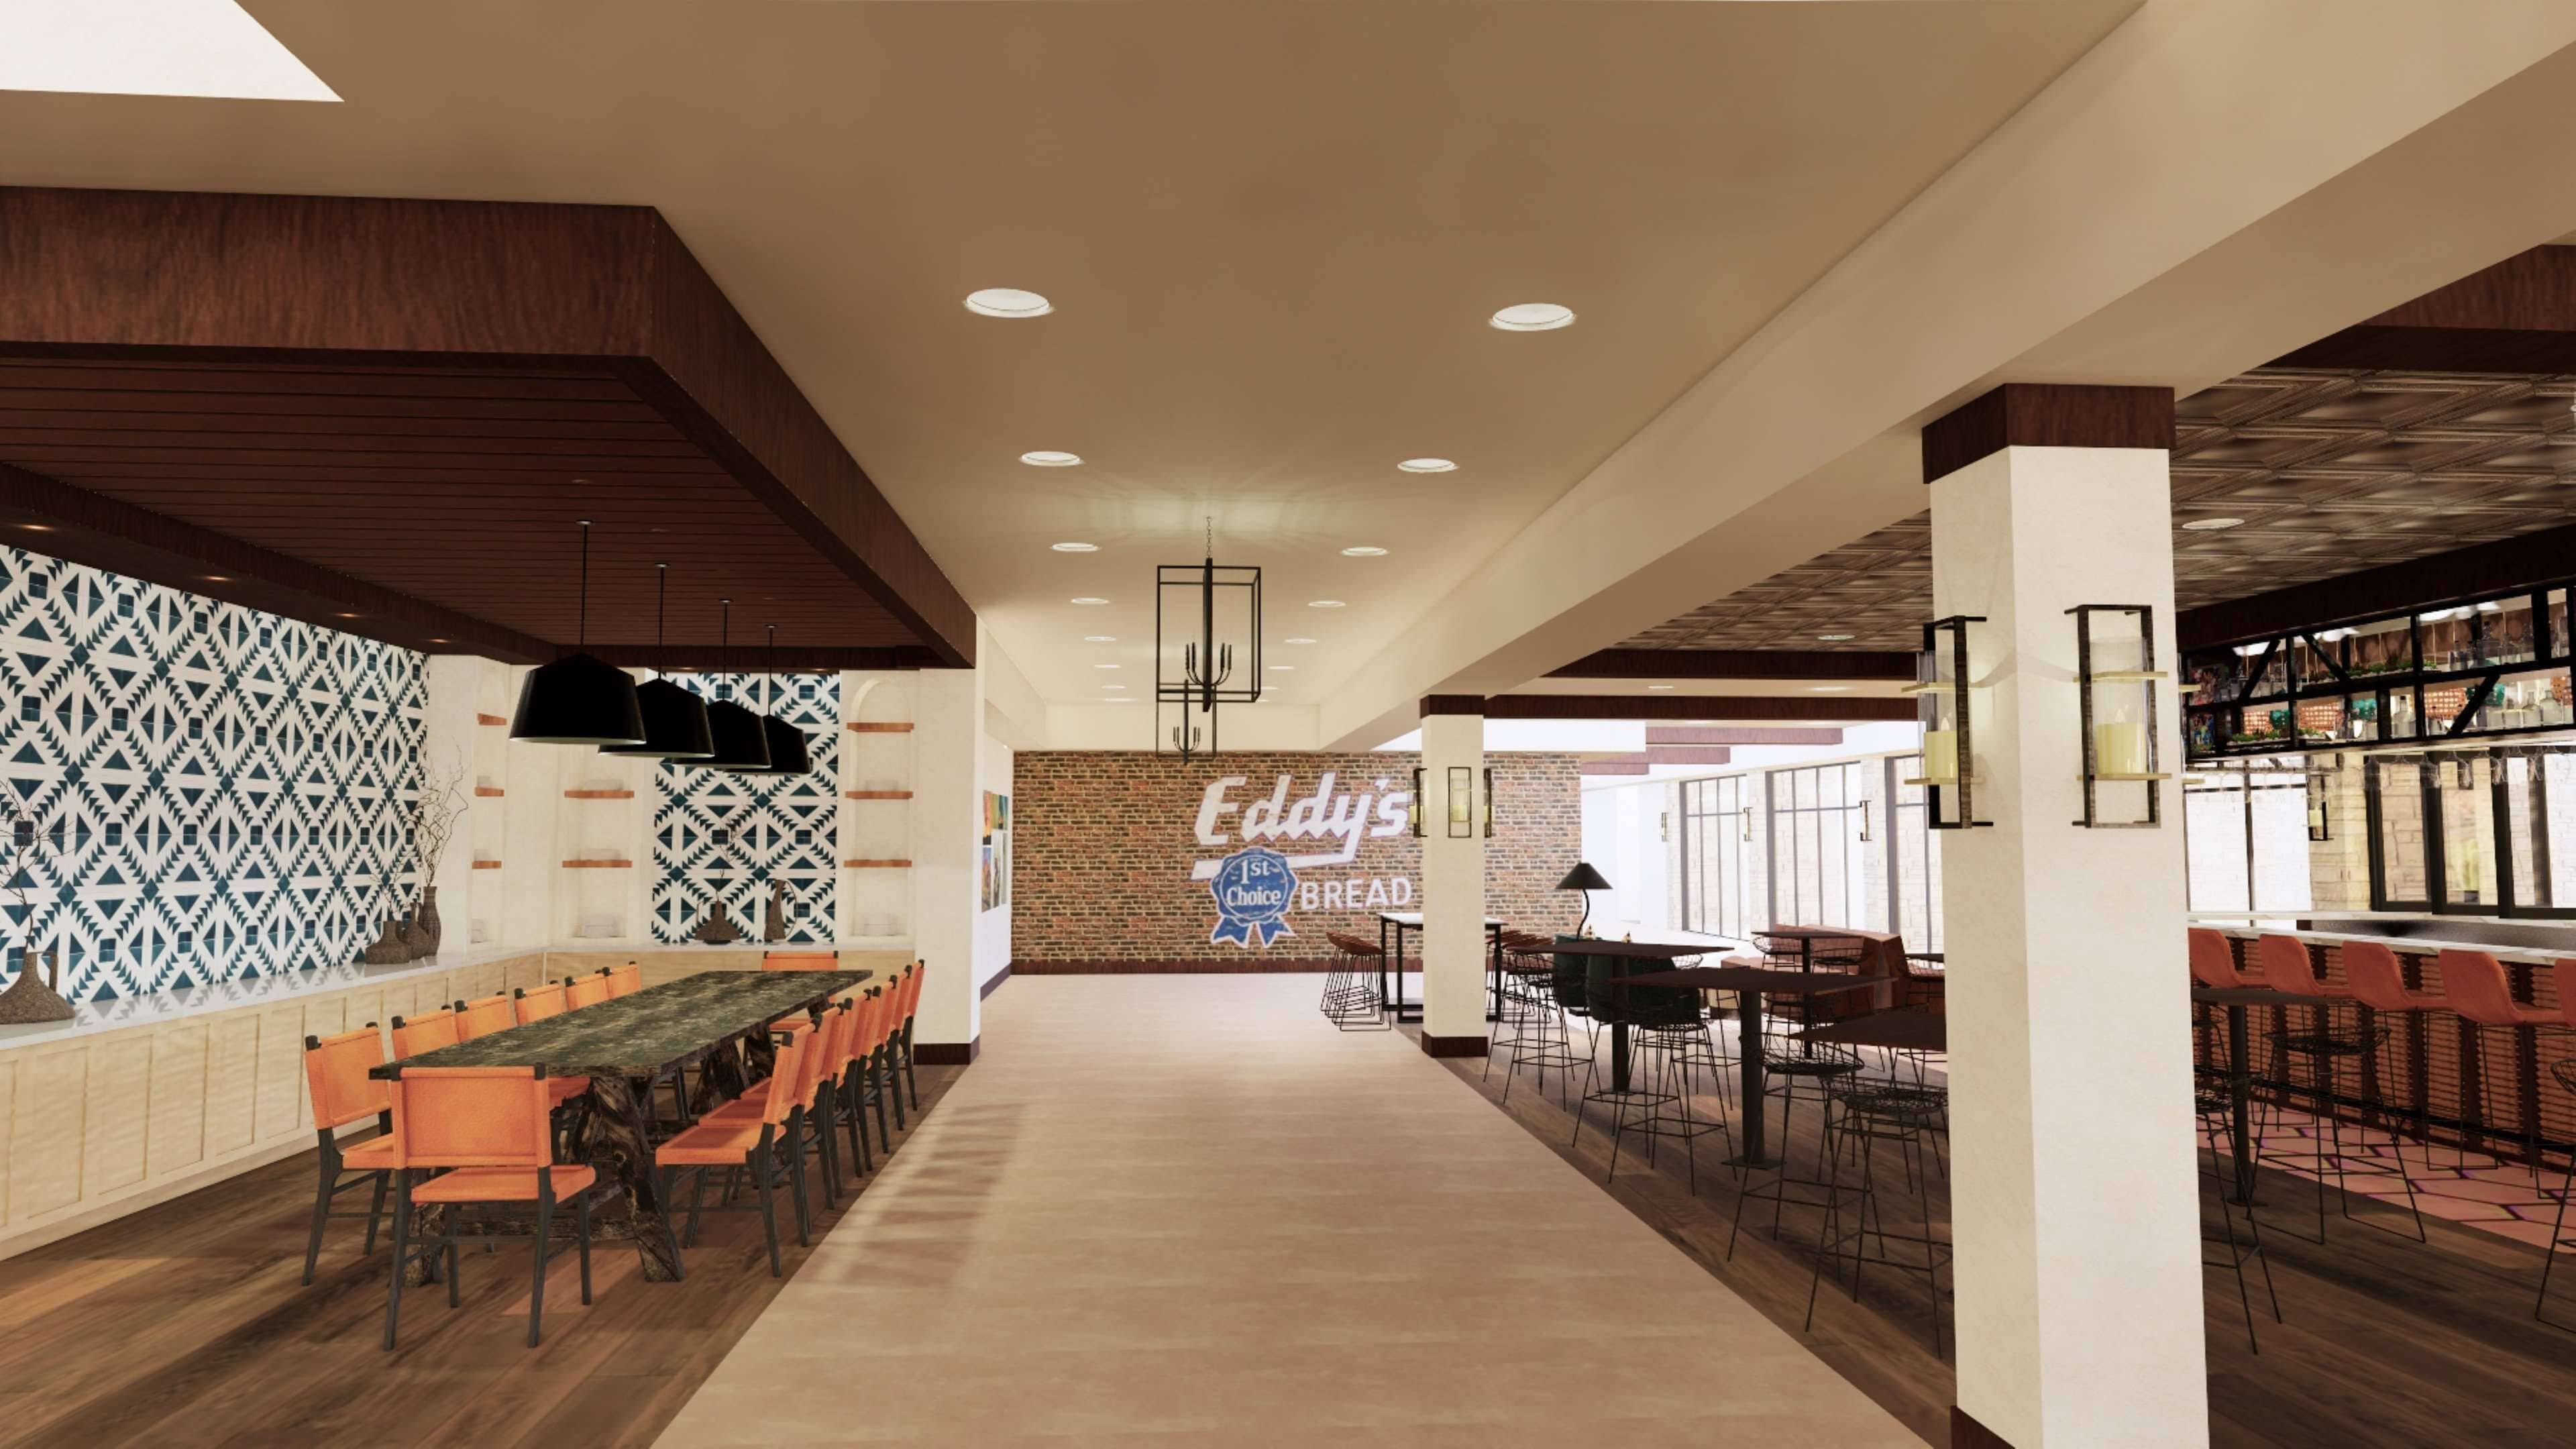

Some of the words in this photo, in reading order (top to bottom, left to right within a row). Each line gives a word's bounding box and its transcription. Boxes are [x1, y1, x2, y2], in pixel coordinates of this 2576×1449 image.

[1193, 771, 1413, 865] Eddy's
[1226, 885, 1282, 906] Choice
[1301, 877, 1412, 910] BREAD
